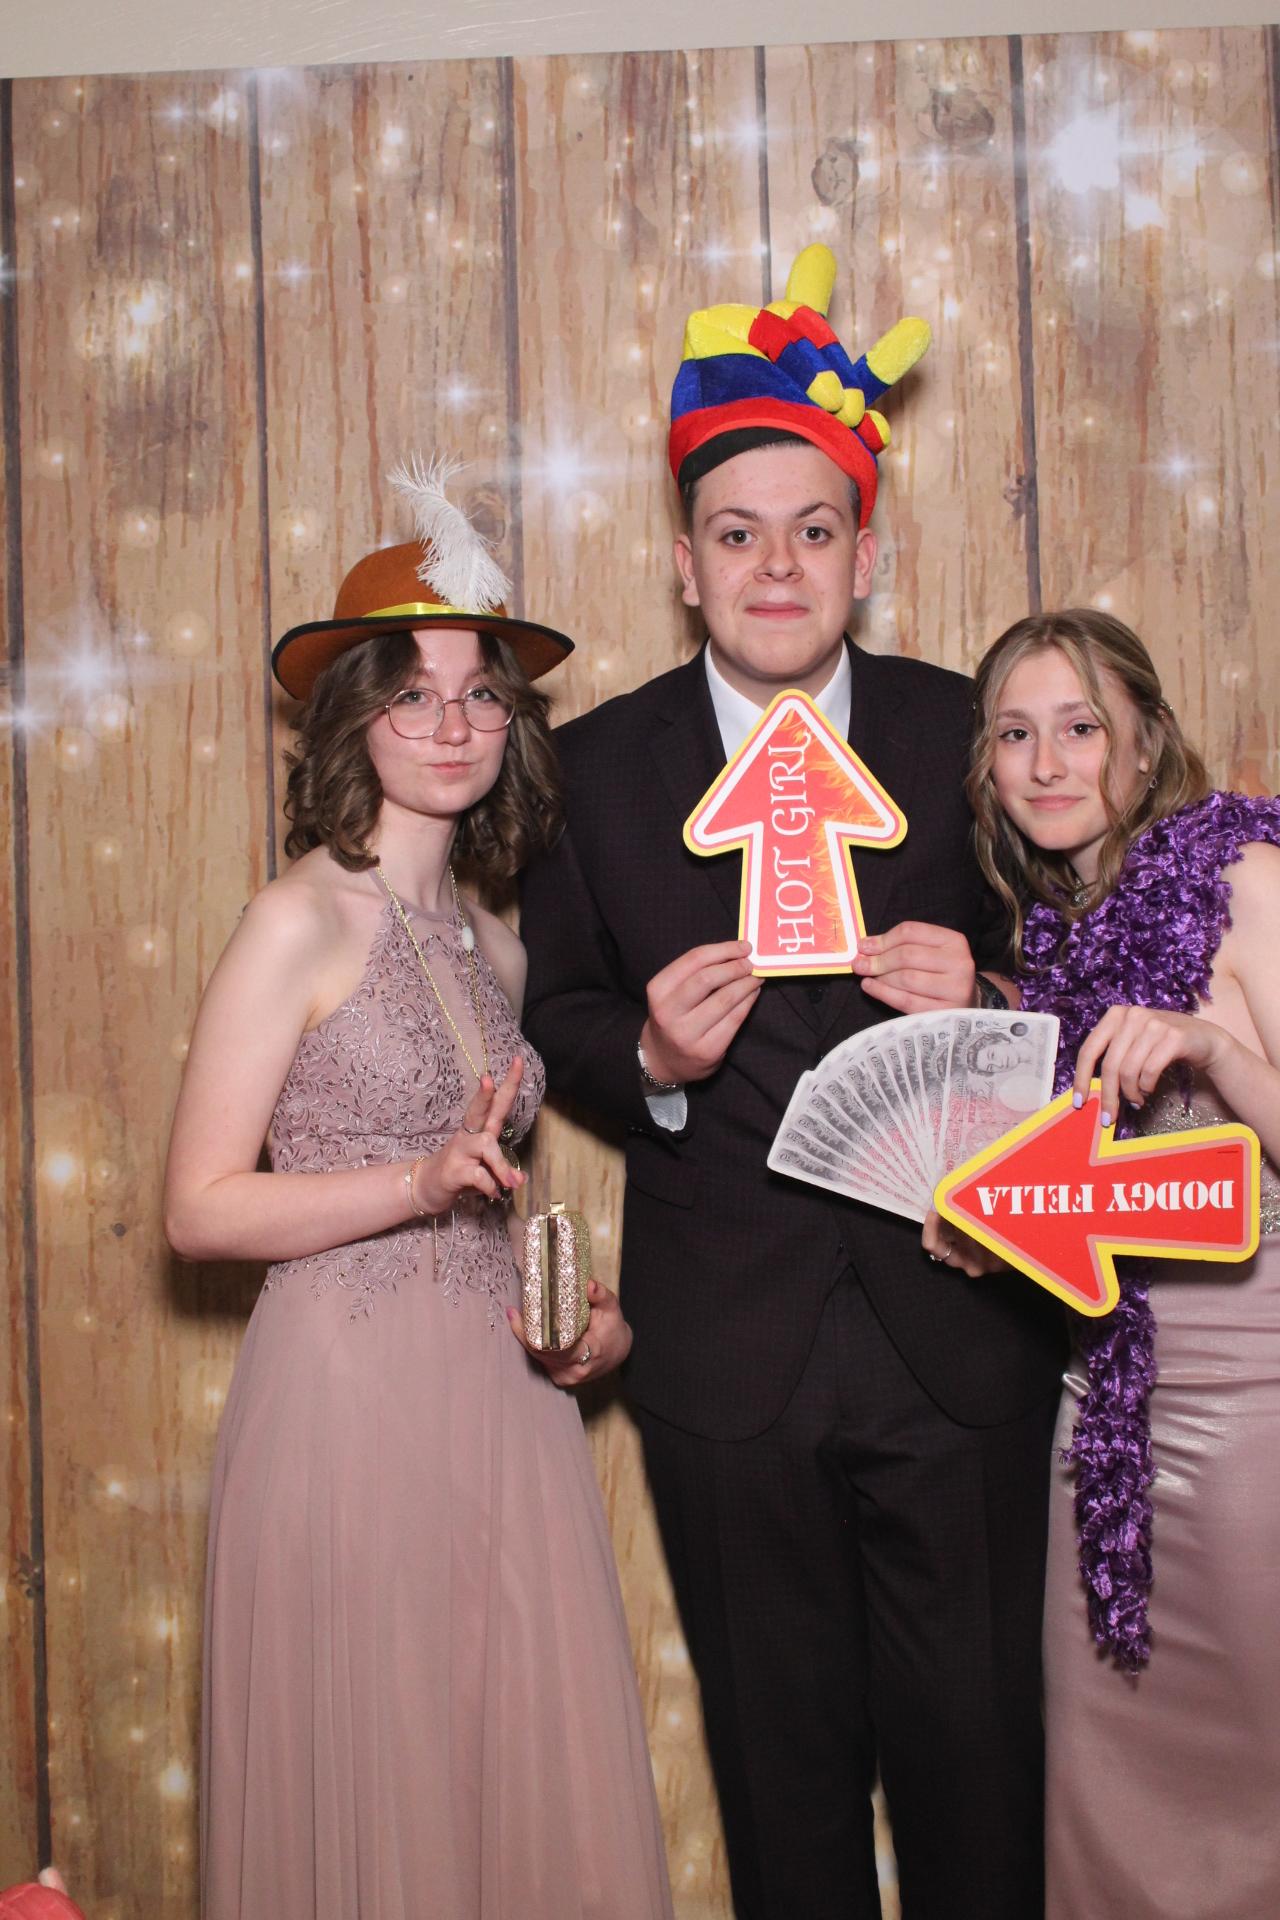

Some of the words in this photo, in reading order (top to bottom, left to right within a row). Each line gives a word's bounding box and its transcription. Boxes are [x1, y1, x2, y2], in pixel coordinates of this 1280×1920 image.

[768, 730, 816, 836] GIRL
[772, 846, 815, 953] HOT
[976, 1184, 1095, 1216] FELLA
[1106, 1180, 1234, 1212] DODGY
